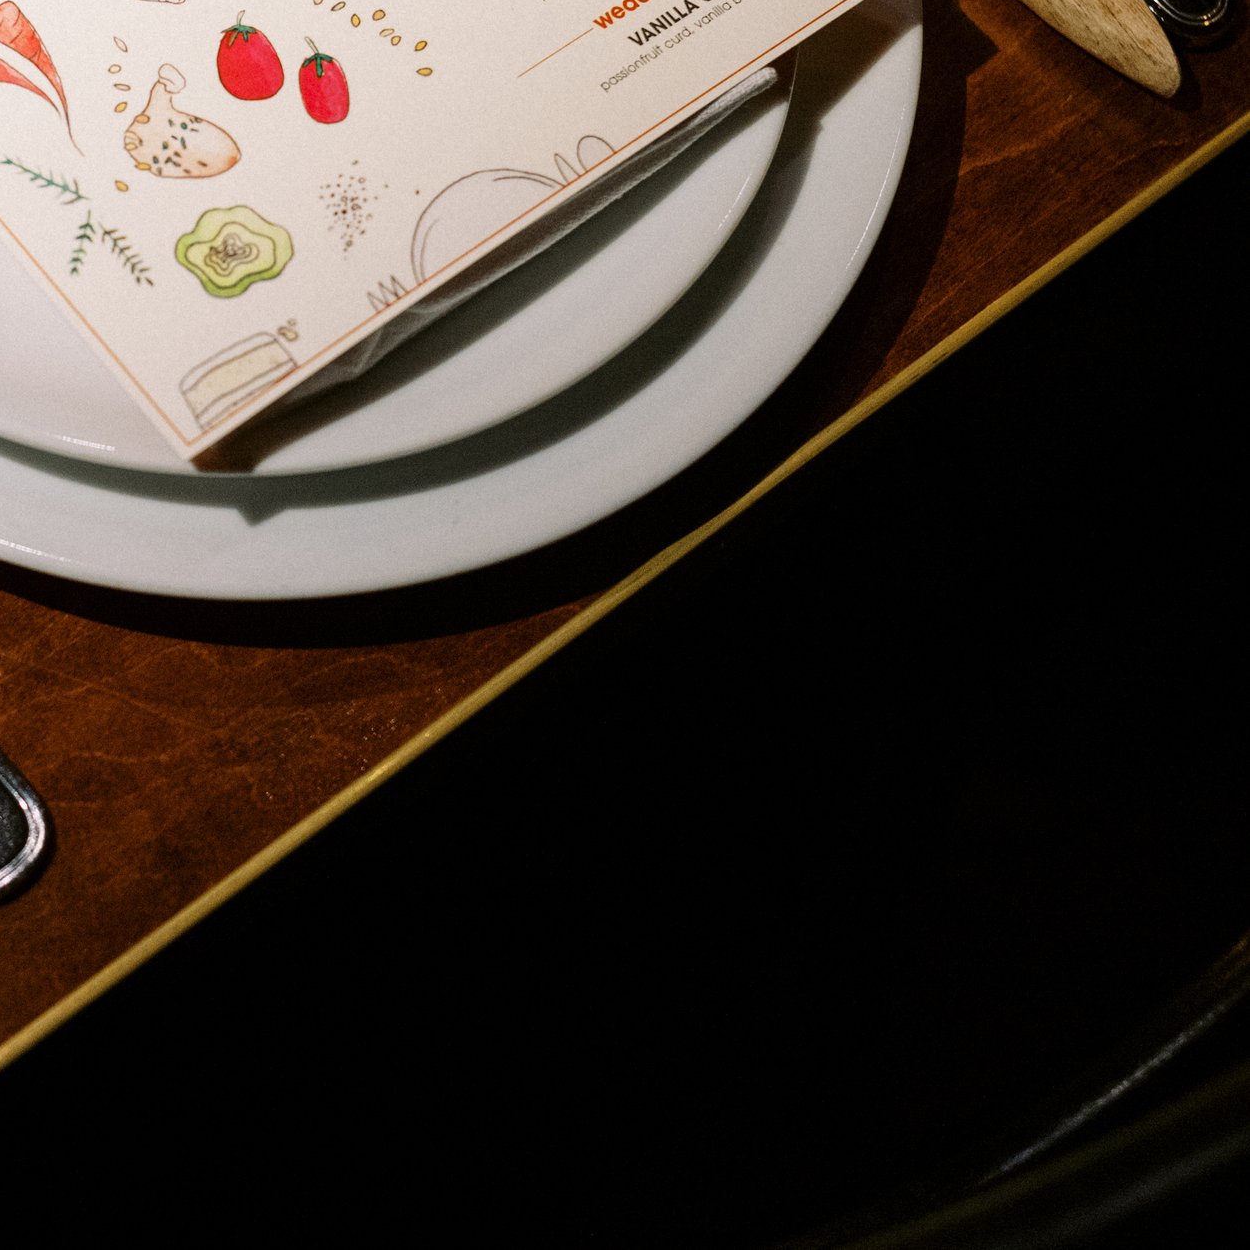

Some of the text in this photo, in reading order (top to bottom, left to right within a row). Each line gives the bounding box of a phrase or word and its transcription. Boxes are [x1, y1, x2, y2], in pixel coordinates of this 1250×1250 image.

[599, 44, 664, 93] passionfruit
[664, 26, 695, 49] curd,
[693, 1, 733, 29] vanilla
[627, 0, 700, 47] VANILLA
